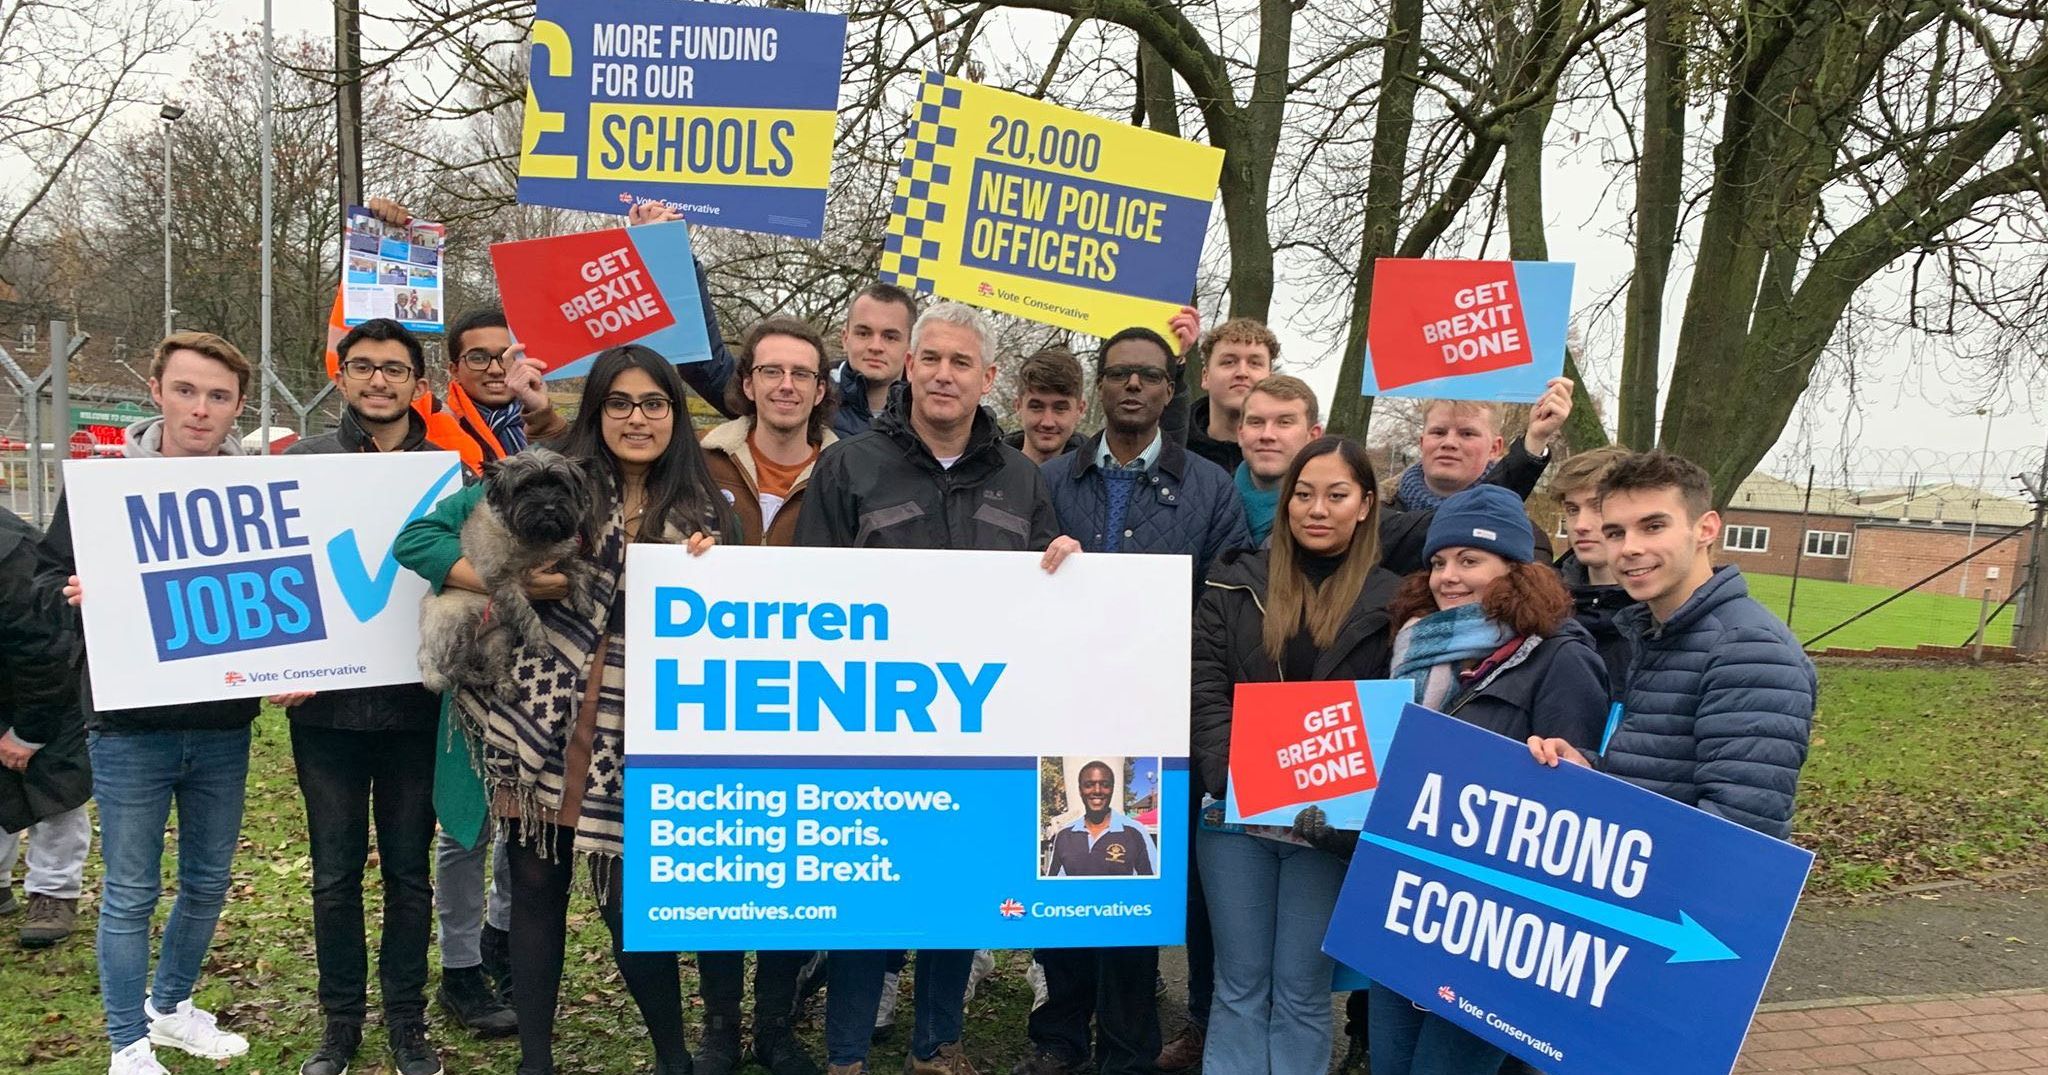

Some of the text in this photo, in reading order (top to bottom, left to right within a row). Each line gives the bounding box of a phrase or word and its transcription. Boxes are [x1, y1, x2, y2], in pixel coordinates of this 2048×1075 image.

[593, 23, 778, 61] MORE FUNDING
[591, 62, 694, 99] FOR OUR
[600, 114, 795, 177] SCHOOLS
[986, 115, 1101, 174] 20,000
[977, 170, 1167, 243] NEW POLICE
[580, 247, 631, 283] GET
[972, 217, 1120, 283] OFFICERS
[559, 269, 644, 323] BREXIT
[997, 288, 1089, 321] Vote Conservative
[1454, 280, 1509, 310] GET
[585, 294, 660, 339] DONE
[1423, 304, 1513, 344] BREXIT
[1442, 328, 1521, 364] DONE
[125, 479, 311, 565] MORE
[166, 566, 312, 651] JOBS
[653, 585, 891, 642] Darren
[249, 664, 367, 682] Vote Conservative
[653, 658, 1008, 734] HENRY
[1303, 701, 1353, 733] GET
[1276, 725, 1358, 769] BREXIT
[1294, 751, 1367, 790] DONE
[650, 783, 961, 818] Backing Broxtowe.
[650, 818, 889, 853] Backing Boris.
[1406, 772, 1652, 899] A STRONG
[650, 854, 901, 889] Backing Brexit.
[648, 901, 837, 921] conservatives.com
[1031, 901, 1152, 918] Conservatives
[1384, 869, 1629, 1009] ECONOMY
[1458, 996, 1563, 1062] Vote Conservative
